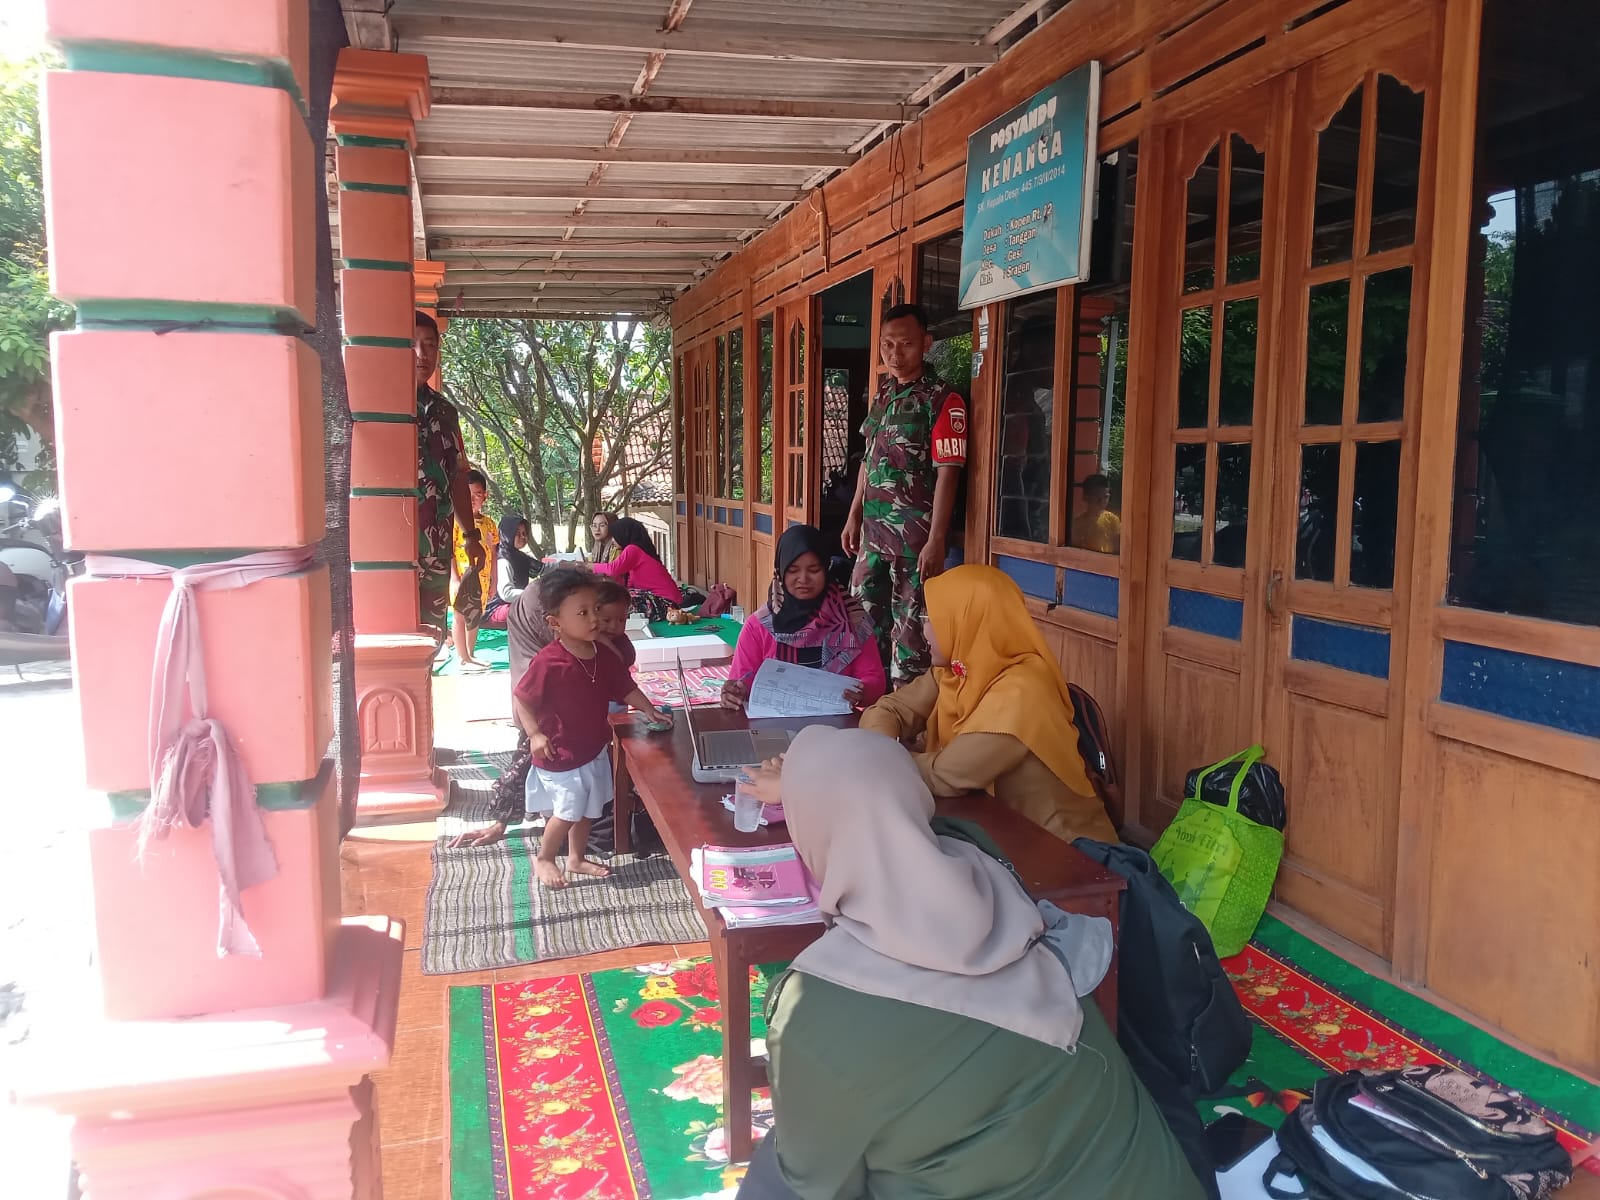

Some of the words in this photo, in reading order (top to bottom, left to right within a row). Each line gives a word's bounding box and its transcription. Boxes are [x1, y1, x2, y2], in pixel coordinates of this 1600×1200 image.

[990, 95, 1058, 153] POSYANDU
[981, 130, 1062, 194] KENANGA
[983, 224, 1002, 241] Dukuh
[1007, 247, 1023, 262] Gesi
[1006, 262, 1031, 278] Sragen
